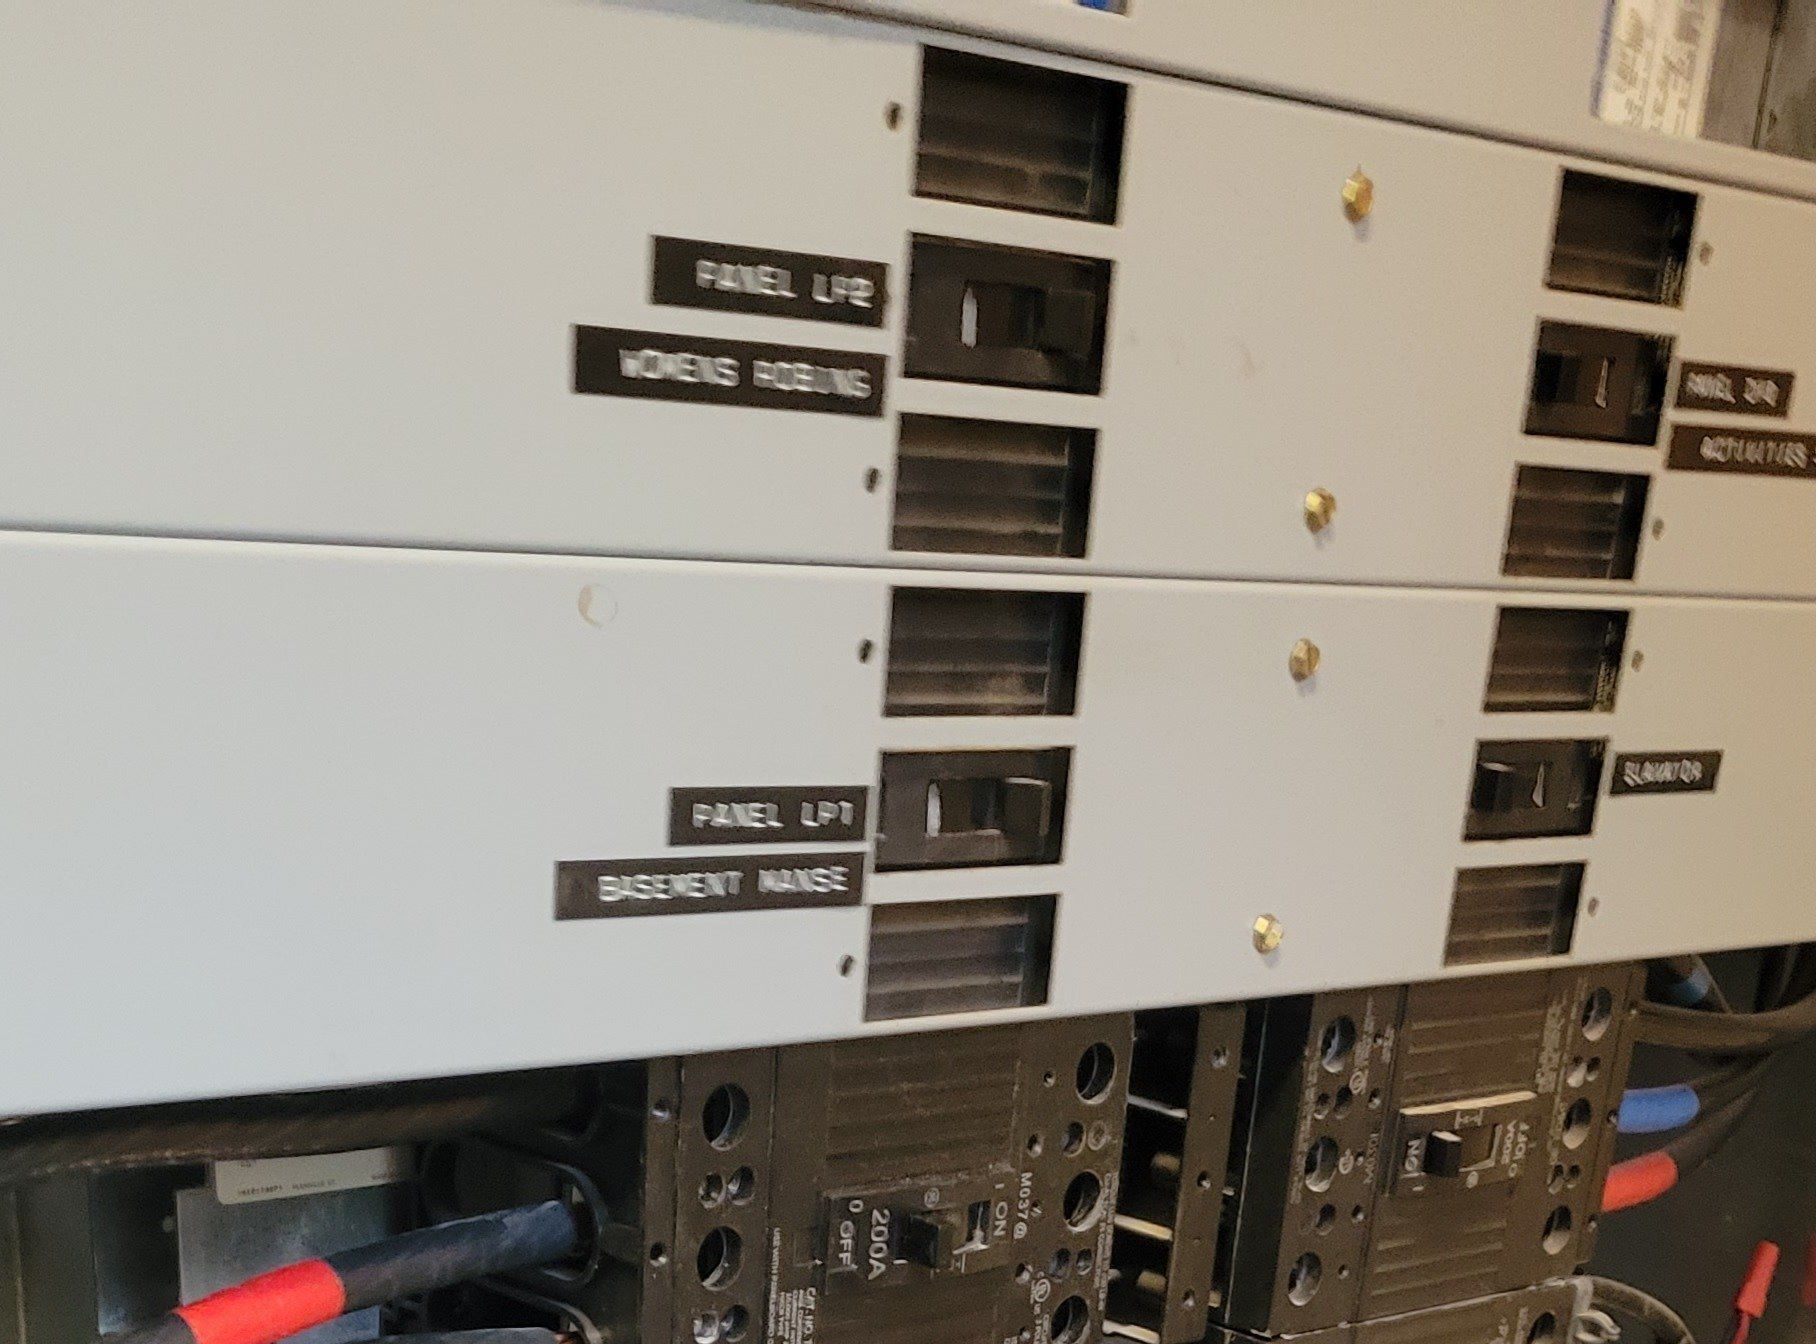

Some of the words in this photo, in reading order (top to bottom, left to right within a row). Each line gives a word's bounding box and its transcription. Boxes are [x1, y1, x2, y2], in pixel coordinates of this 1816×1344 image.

[696, 260, 797, 298] PANEL
[619, 349, 741, 387] WOMENS
[693, 803, 784, 828] PANEL
[598, 871, 744, 902] BASEMENT
[758, 866, 850, 893] MANSE
[1017, 1172, 1033, 1220] M037
[993, 1201, 1008, 1237] ON
[838, 1220, 855, 1266] OFF
[868, 1208, 891, 1281] 200A
